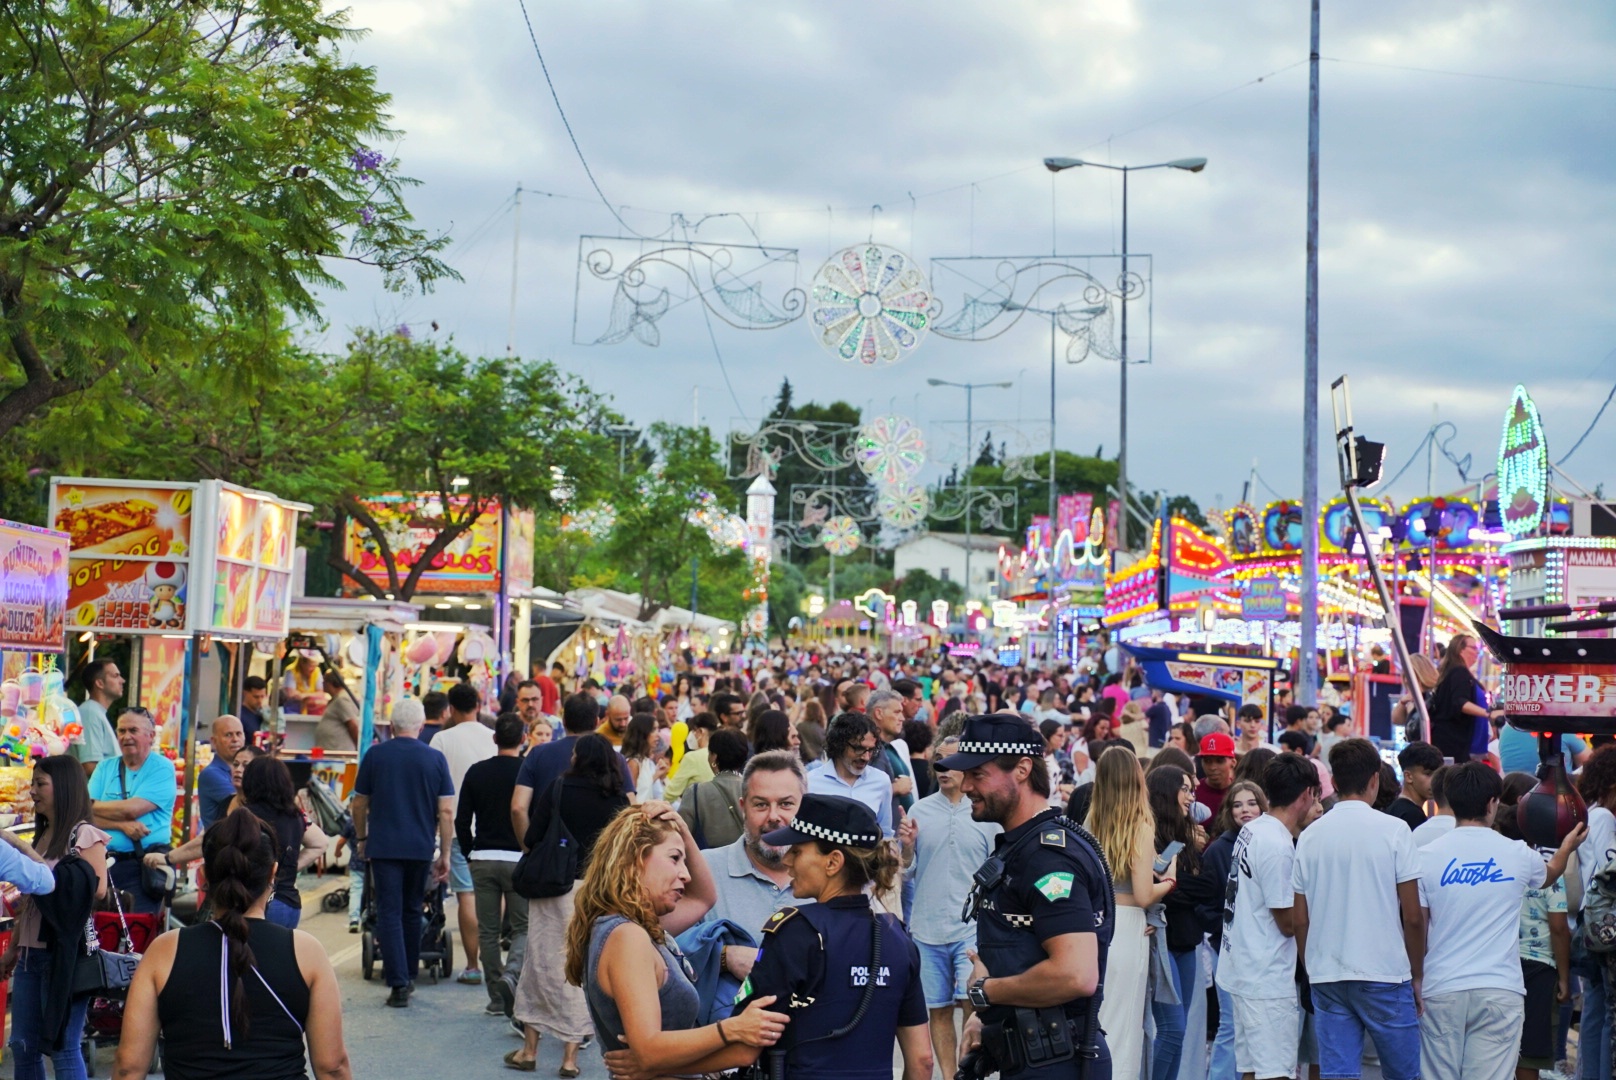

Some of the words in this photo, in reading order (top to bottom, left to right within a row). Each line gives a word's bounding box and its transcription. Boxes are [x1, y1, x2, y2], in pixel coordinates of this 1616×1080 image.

[3, 540, 48, 584] BUÑUELOS
[1568, 551, 1613, 567] MAXIMA
[3, 579, 43, 606] ALGODÓN
[106, 583, 150, 600] XXL
[8, 609, 35, 633] DULCE
[1506, 674, 1601, 704] BOXER
[1516, 703, 1541, 712] WANTED
[850, 966, 890, 977] POLIA
[853, 976, 887, 986] LOAL
